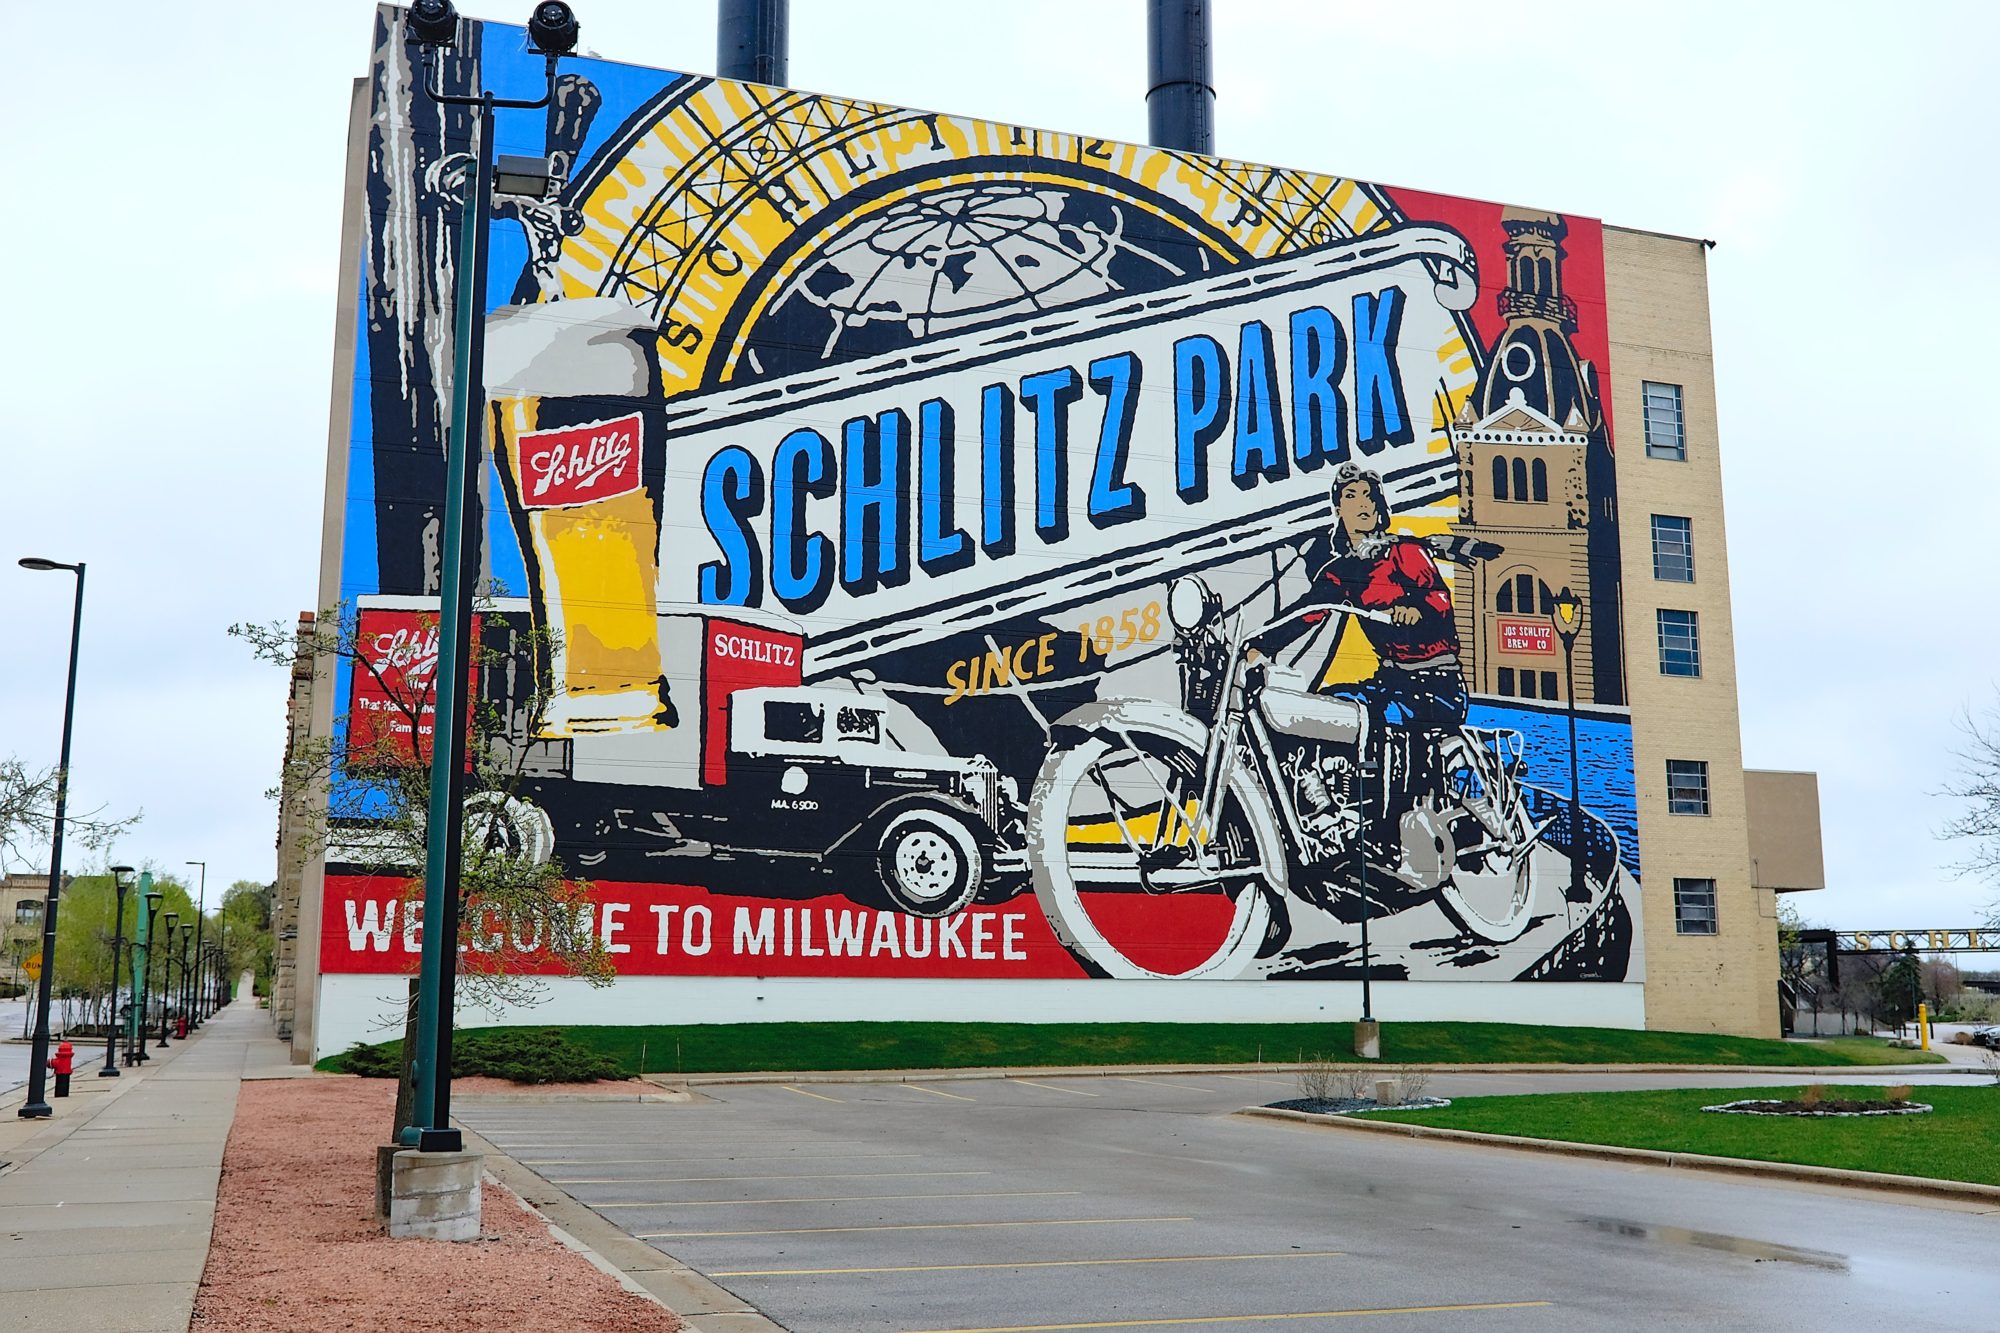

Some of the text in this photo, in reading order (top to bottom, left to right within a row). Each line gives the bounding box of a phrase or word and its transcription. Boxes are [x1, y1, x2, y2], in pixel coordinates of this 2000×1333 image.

[530, 431, 632, 497] Schlitz
[699, 285, 1415, 613] SCHLITZ PARK
[714, 633, 795, 667] SCHLITZ
[943, 600, 1161, 706] SINCE 1858
[1503, 626, 1550, 638] JOS SCHLITZ
[1507, 639, 1547, 650] BREW CO
[390, 720, 432, 735] Famus
[345, 899, 1027, 960] WECOME TO MILWAUKEE
